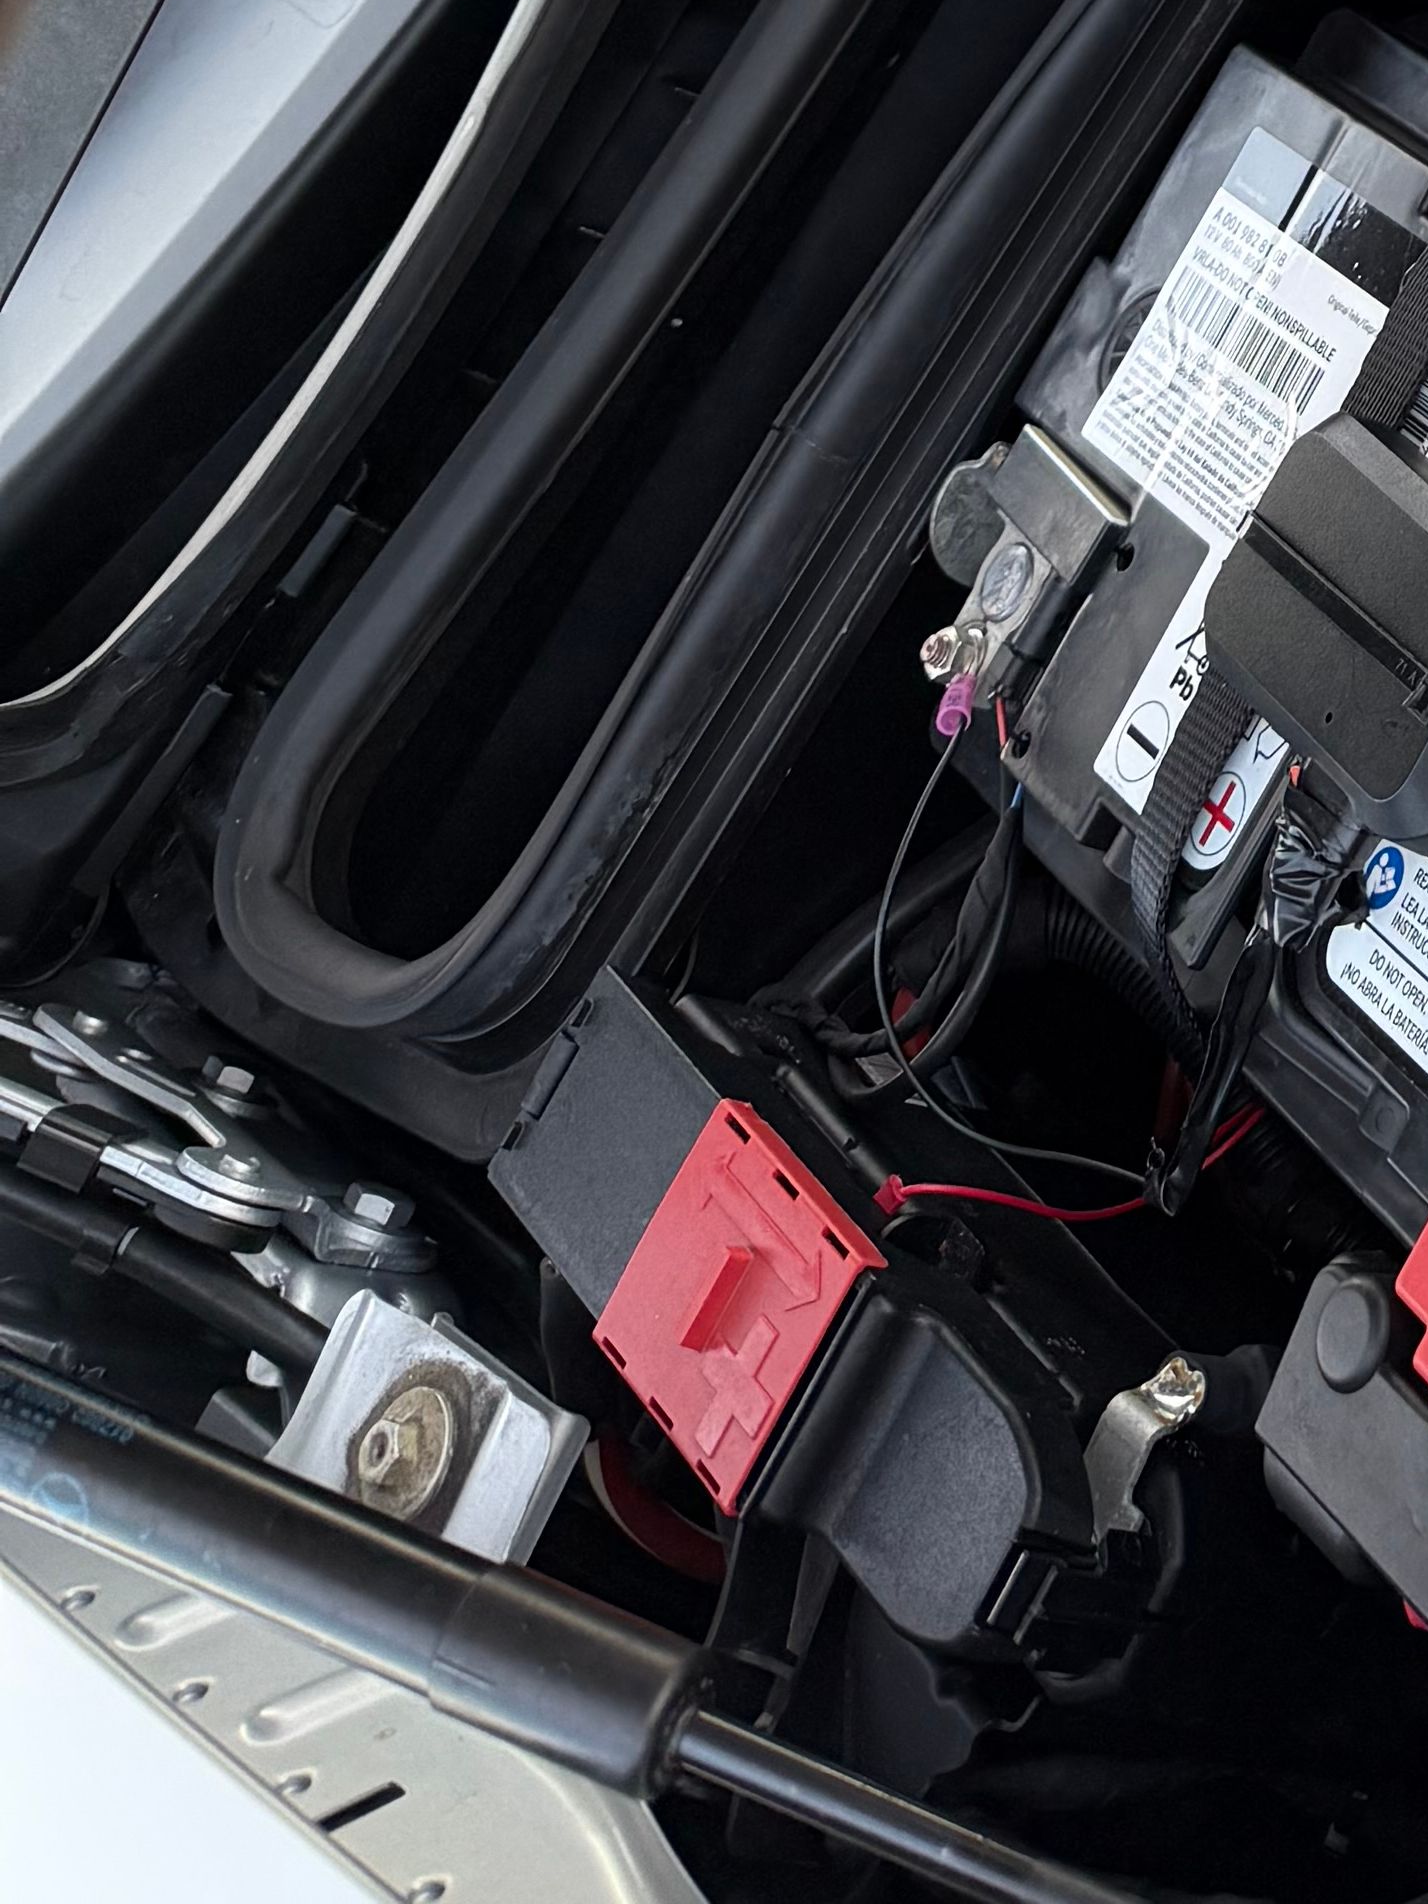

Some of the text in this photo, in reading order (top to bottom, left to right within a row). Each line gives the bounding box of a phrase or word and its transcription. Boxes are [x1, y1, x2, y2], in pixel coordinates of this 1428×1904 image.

[1212, 204, 1226, 222] A
[1220, 210, 1243, 235] 001
[1238, 223, 1261, 249] 982
[1269, 304, 1336, 363] NONSPILLABLE
[1165, 666, 1201, 702] Pb
[1400, 891, 1422, 919] LEA
[1339, 959, 1362, 990] ¡NO
[1356, 975, 1384, 1008] ABRA
[1379, 997, 1396, 1020] LA
[1368, 948, 1387, 973] DO
[1381, 961, 1405, 991] NOT
